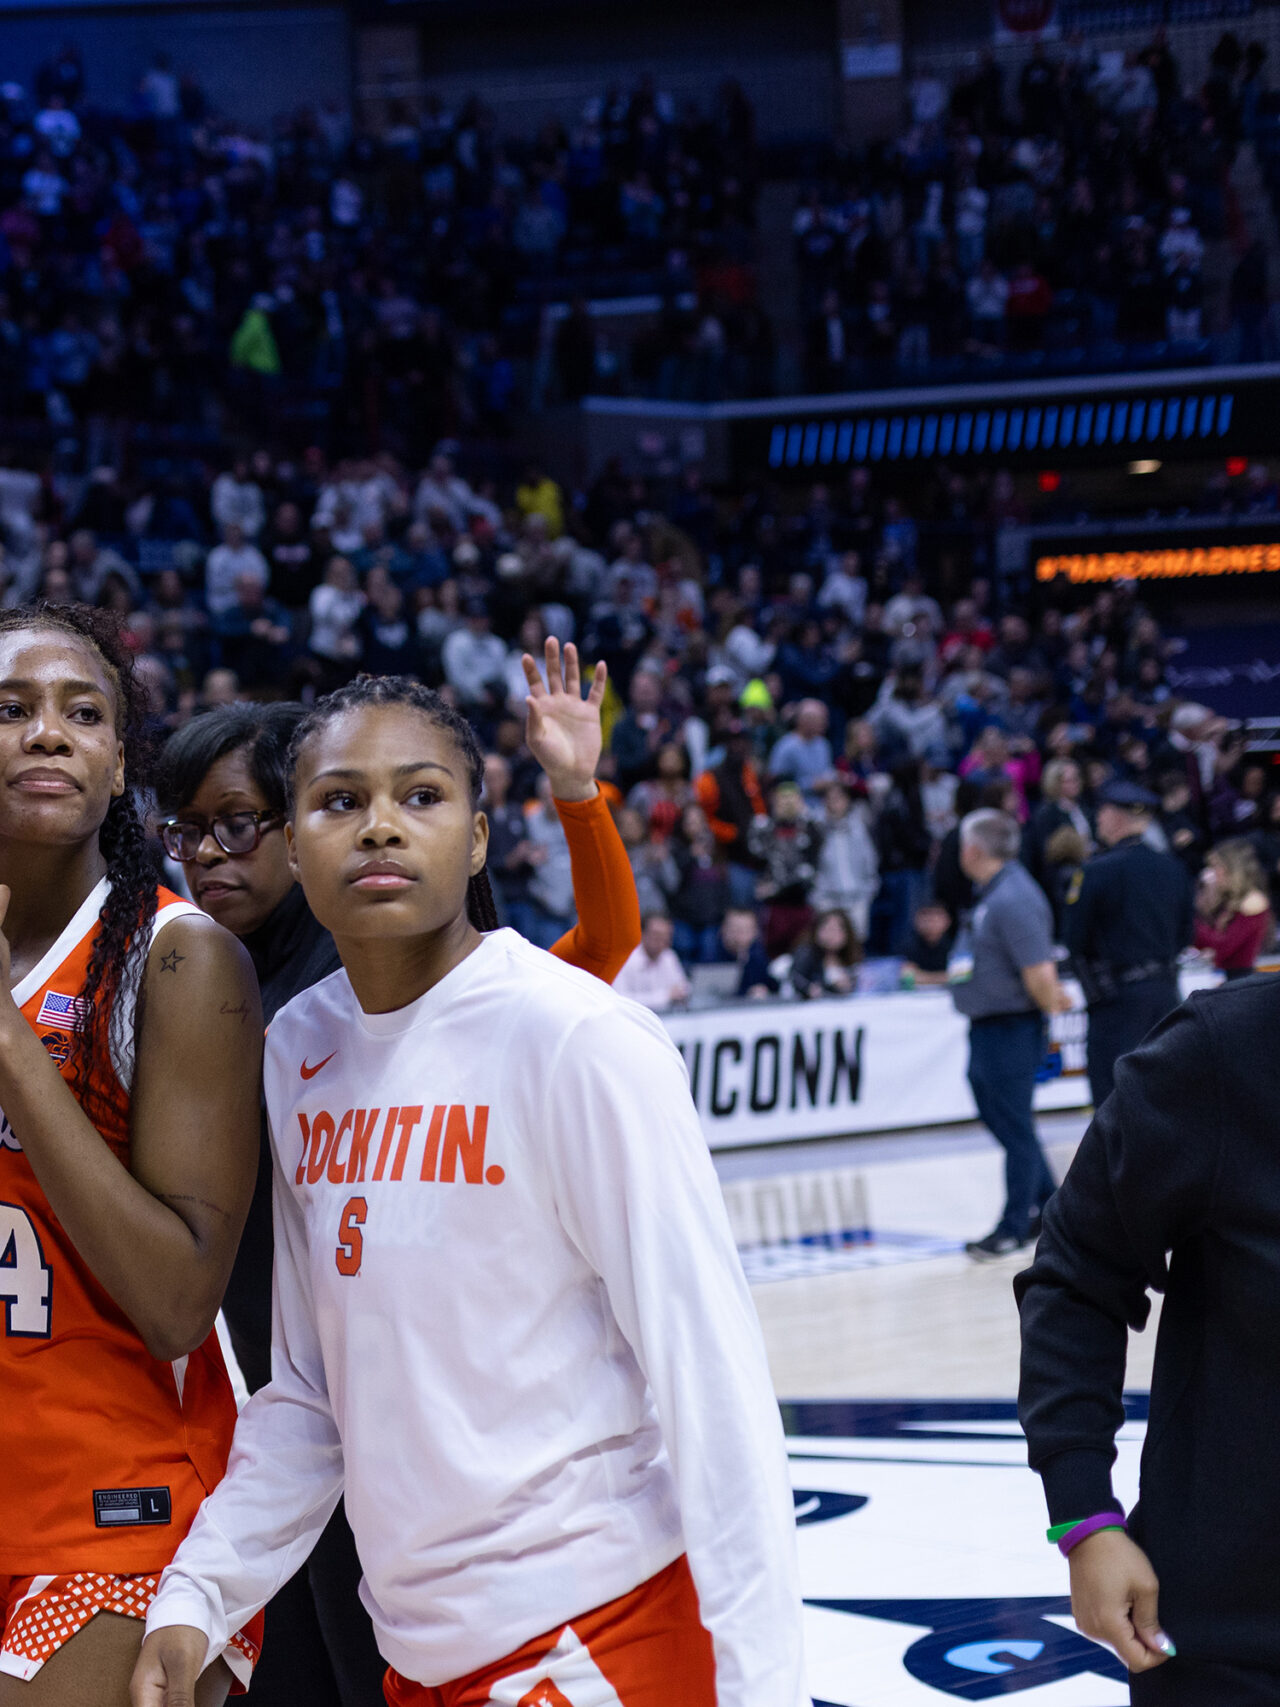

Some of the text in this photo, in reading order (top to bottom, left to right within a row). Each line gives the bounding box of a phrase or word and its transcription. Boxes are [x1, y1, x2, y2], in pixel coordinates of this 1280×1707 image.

[371, 1105, 424, 1182] IT
[420, 1104, 505, 1186] IN.
[336, 1197, 368, 1277] S
[151, 1498, 160, 1513] L
